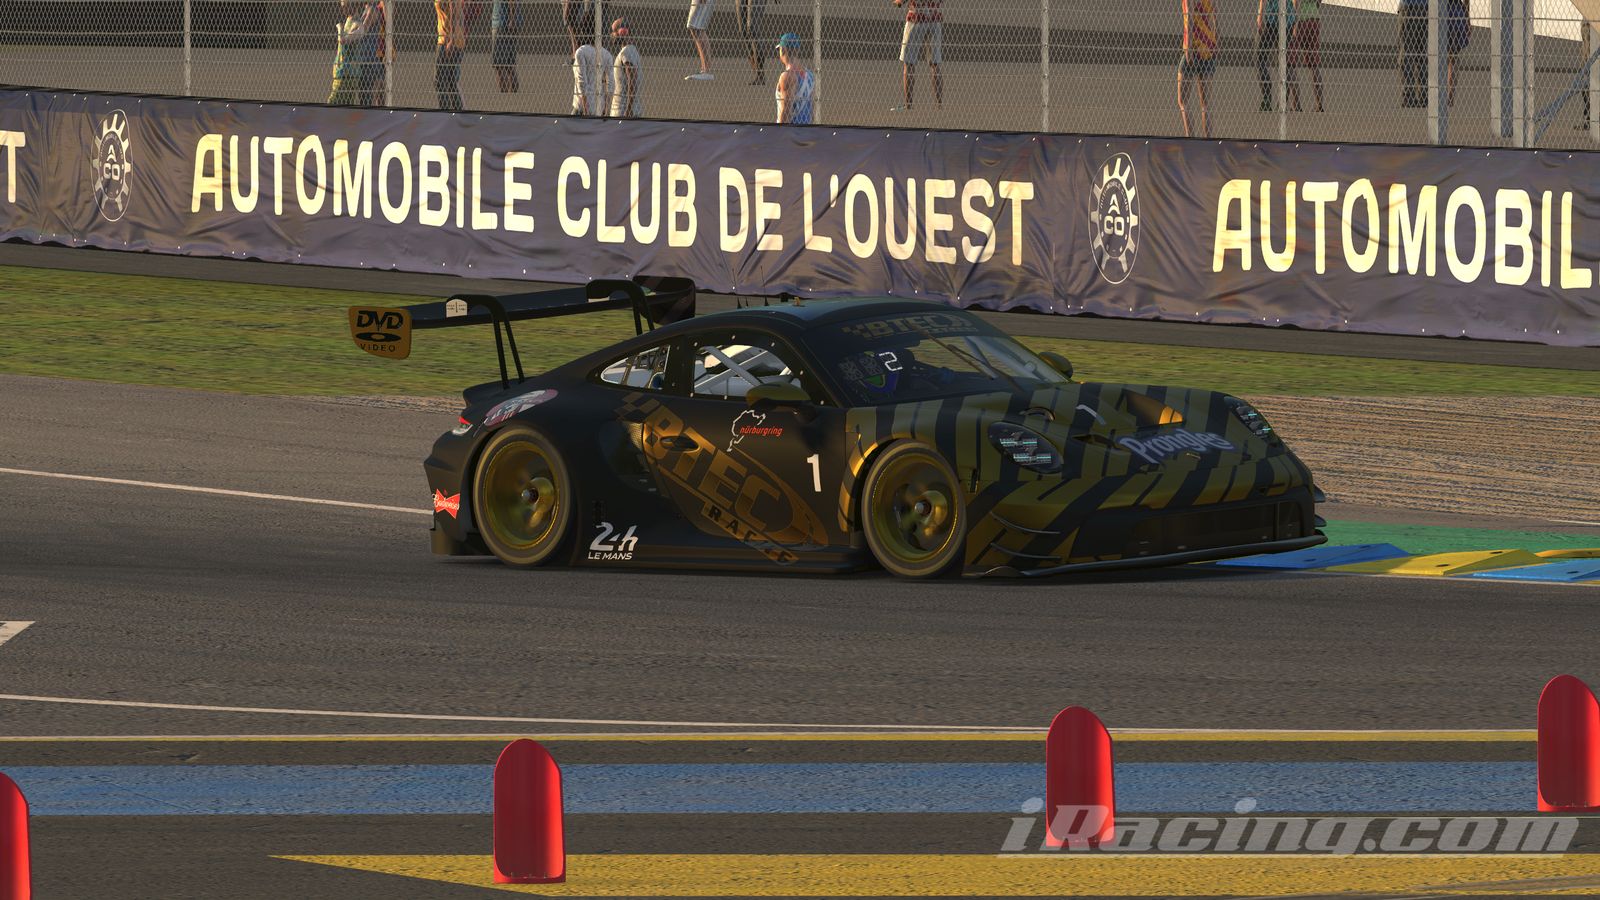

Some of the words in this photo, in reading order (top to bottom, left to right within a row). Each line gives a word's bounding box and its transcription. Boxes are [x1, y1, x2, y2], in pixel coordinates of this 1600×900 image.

[191, 133, 535, 233] AUTOMOBILE
[557, 155, 698, 249] CLUB
[719, 167, 784, 252] DE
[803, 172, 1035, 266] L'OUEST
[1212, 178, 1600, 291] AUTOMOBIL
[356, 310, 403, 331] DVD
[360, 343, 396, 353] VIDEO
[878, 351, 903, 372] 2
[740, 426, 784, 437] nürburgring
[806, 453, 822, 492] 1
[588, 551, 602, 560] LE
[601, 552, 633, 560] MANS
